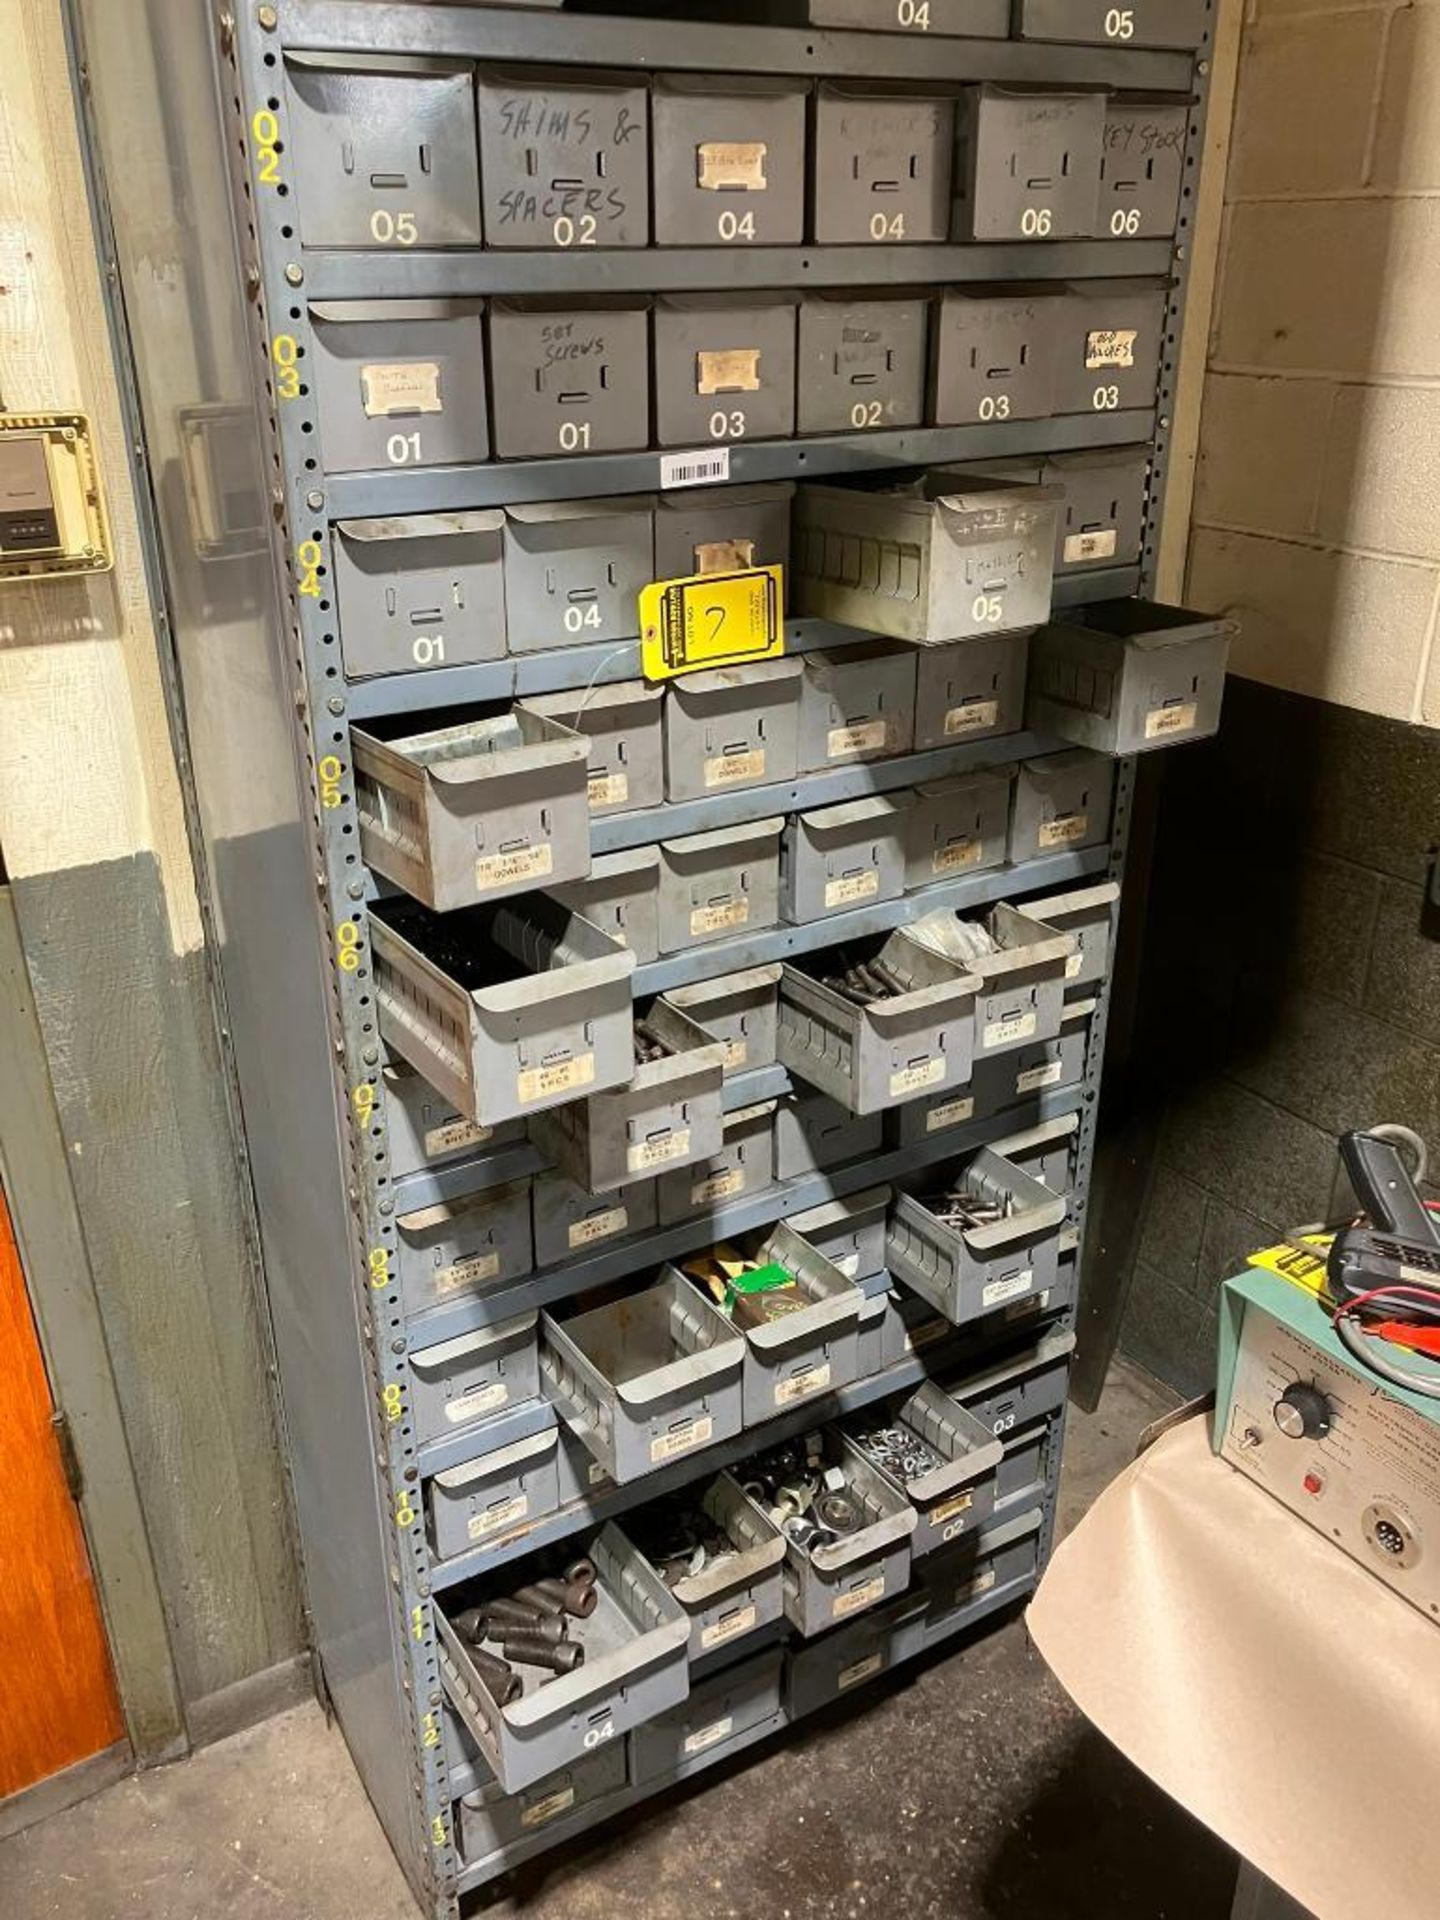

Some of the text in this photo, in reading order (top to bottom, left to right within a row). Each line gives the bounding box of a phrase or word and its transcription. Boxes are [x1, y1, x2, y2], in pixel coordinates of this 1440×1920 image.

[898, 0, 930, 30] 04
[1105, 9, 1134, 38] 05
[612, 109, 643, 144] &
[251, 109, 281, 185] 02
[498, 187, 625, 224] SPACERS
[371, 210, 417, 243] 05
[553, 215, 597, 246] 02
[718, 211, 756, 240] 04
[870, 212, 905, 240] 04
[1021, 208, 1052, 236] 06
[1111, 209, 1141, 235] 06
[270, 335, 301, 400] 03
[978, 395, 1010, 420] 03
[1093, 385, 1119, 410] 03
[709, 411, 745, 438] 03
[851, 401, 882, 428] 02
[387, 433, 422, 463] 01
[559, 422, 590, 450] 01
[564, 605, 601, 632] 04
[972, 595, 1002, 623] 05
[412, 636, 445, 664] 01
[316, 754, 343, 809] 05
[335, 920, 362, 974] 06
[993, 1413, 1016, 1436] 03
[395, 1491, 416, 1528] 10
[583, 1720, 615, 1749] 04
